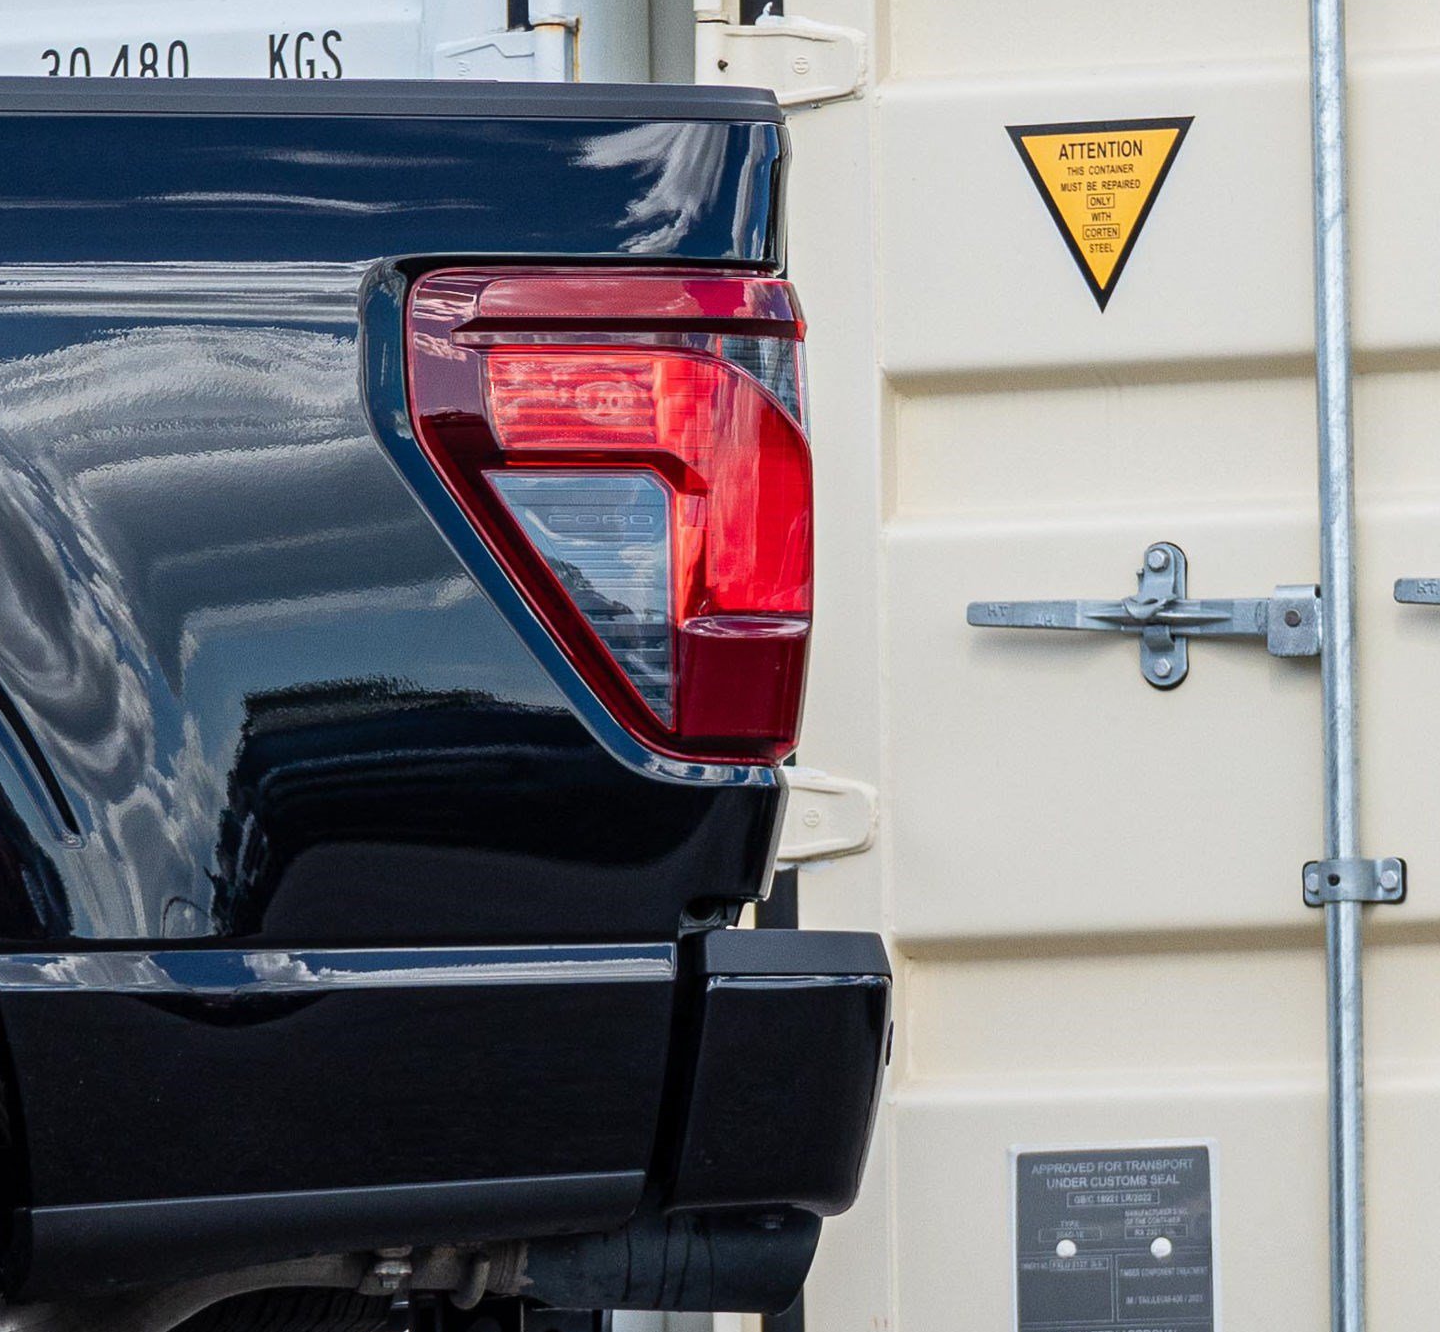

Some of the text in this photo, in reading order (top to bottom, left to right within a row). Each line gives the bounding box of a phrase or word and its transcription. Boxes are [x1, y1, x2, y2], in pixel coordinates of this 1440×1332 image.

[269, 29, 342, 79] KGS
[1058, 140, 1143, 160] ATTENTION
[1067, 164, 1134, 176] THIS CONTAINER
[1060, 180, 1140, 192] MUST BE REPAIRED
[1090, 197, 1111, 207] ONLY
[1091, 212, 1111, 222] WITH
[1085, 227, 1118, 238] CORTEN
[1089, 243, 1114, 254] STEEL
[548, 514, 653, 525] FORD
[1032, 1158, 1194, 1175] APPROVED FOR TRANSPORT
[1046, 1173, 1180, 1189] UNDER CUSTOMS SEAL
